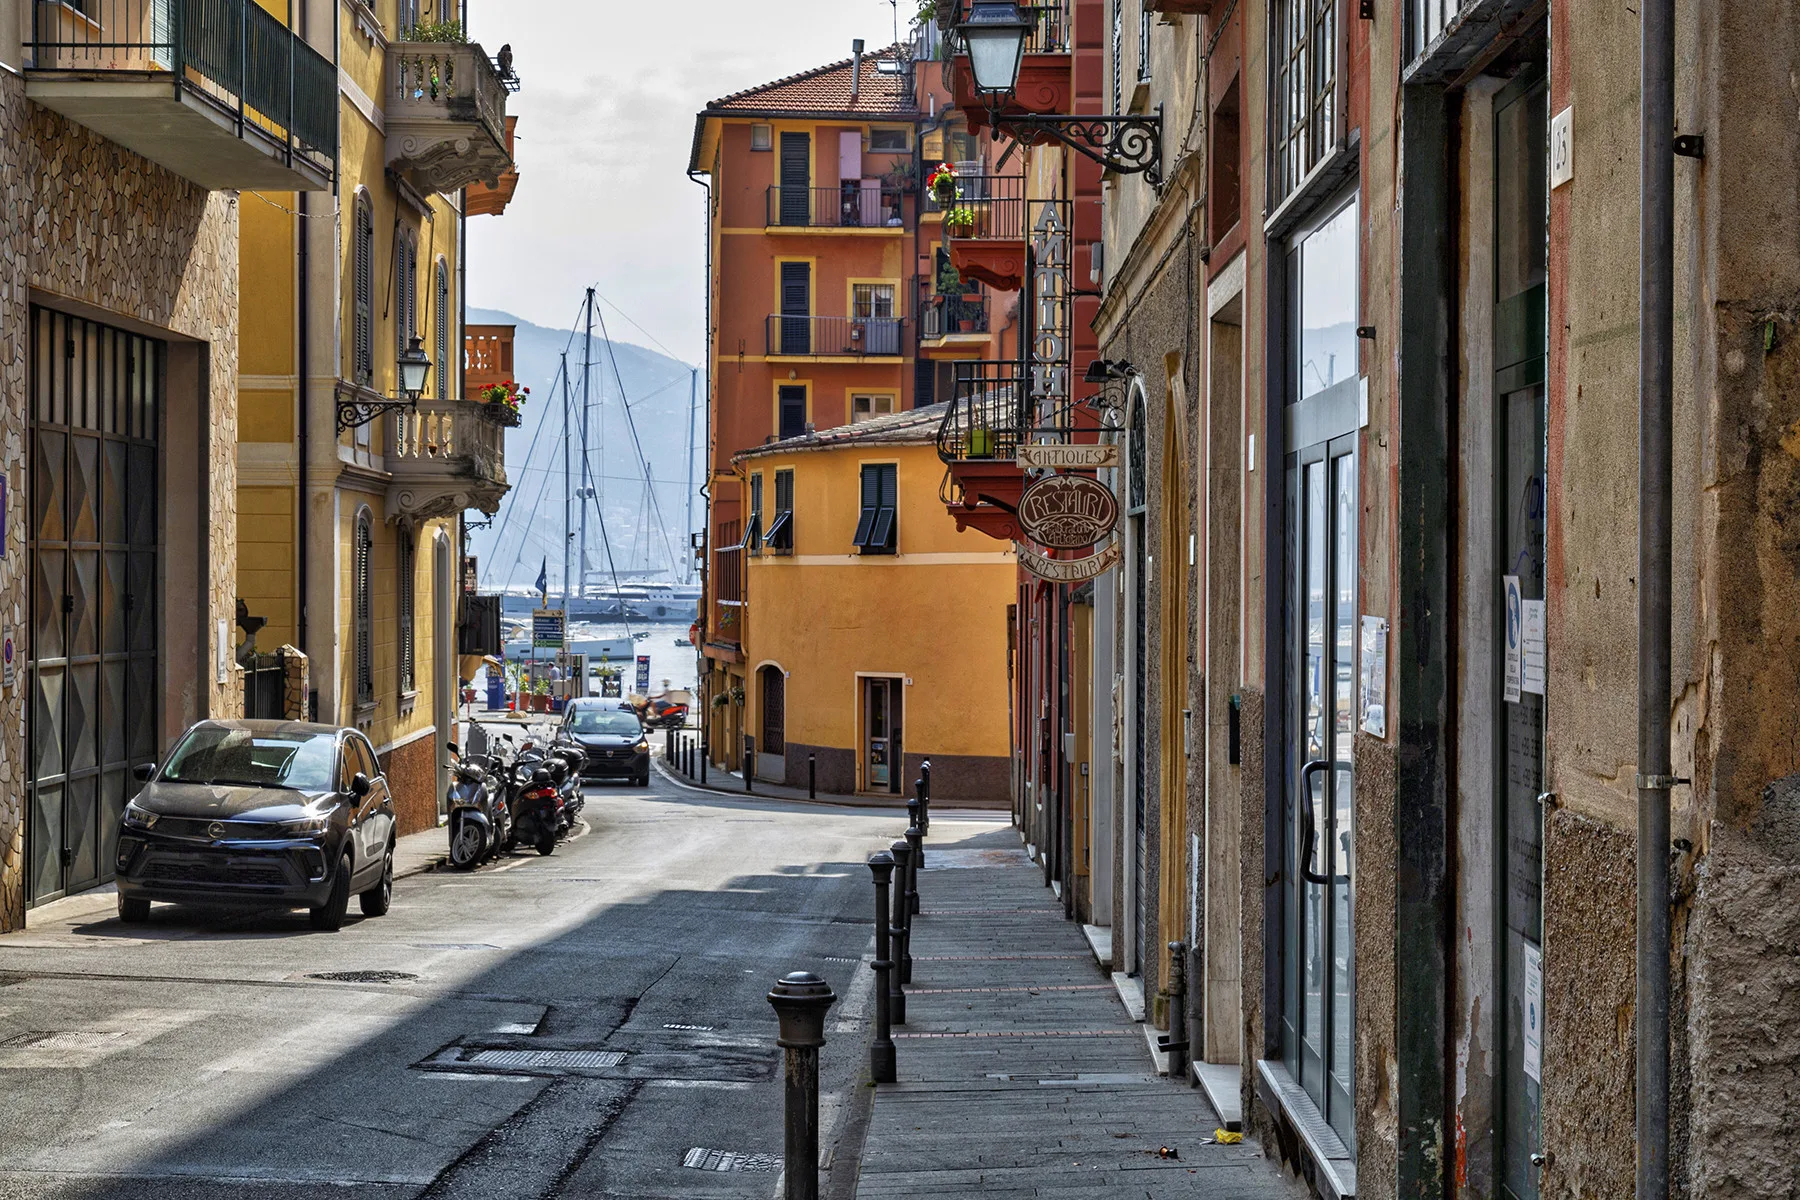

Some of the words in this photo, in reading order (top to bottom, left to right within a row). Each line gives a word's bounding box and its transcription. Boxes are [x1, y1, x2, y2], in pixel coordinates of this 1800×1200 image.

[1033, 449, 1102, 465] ANTIQUES
[1030, 491, 1104, 519] RESTAURI
[1035, 557, 1102, 579] RESTAURI
